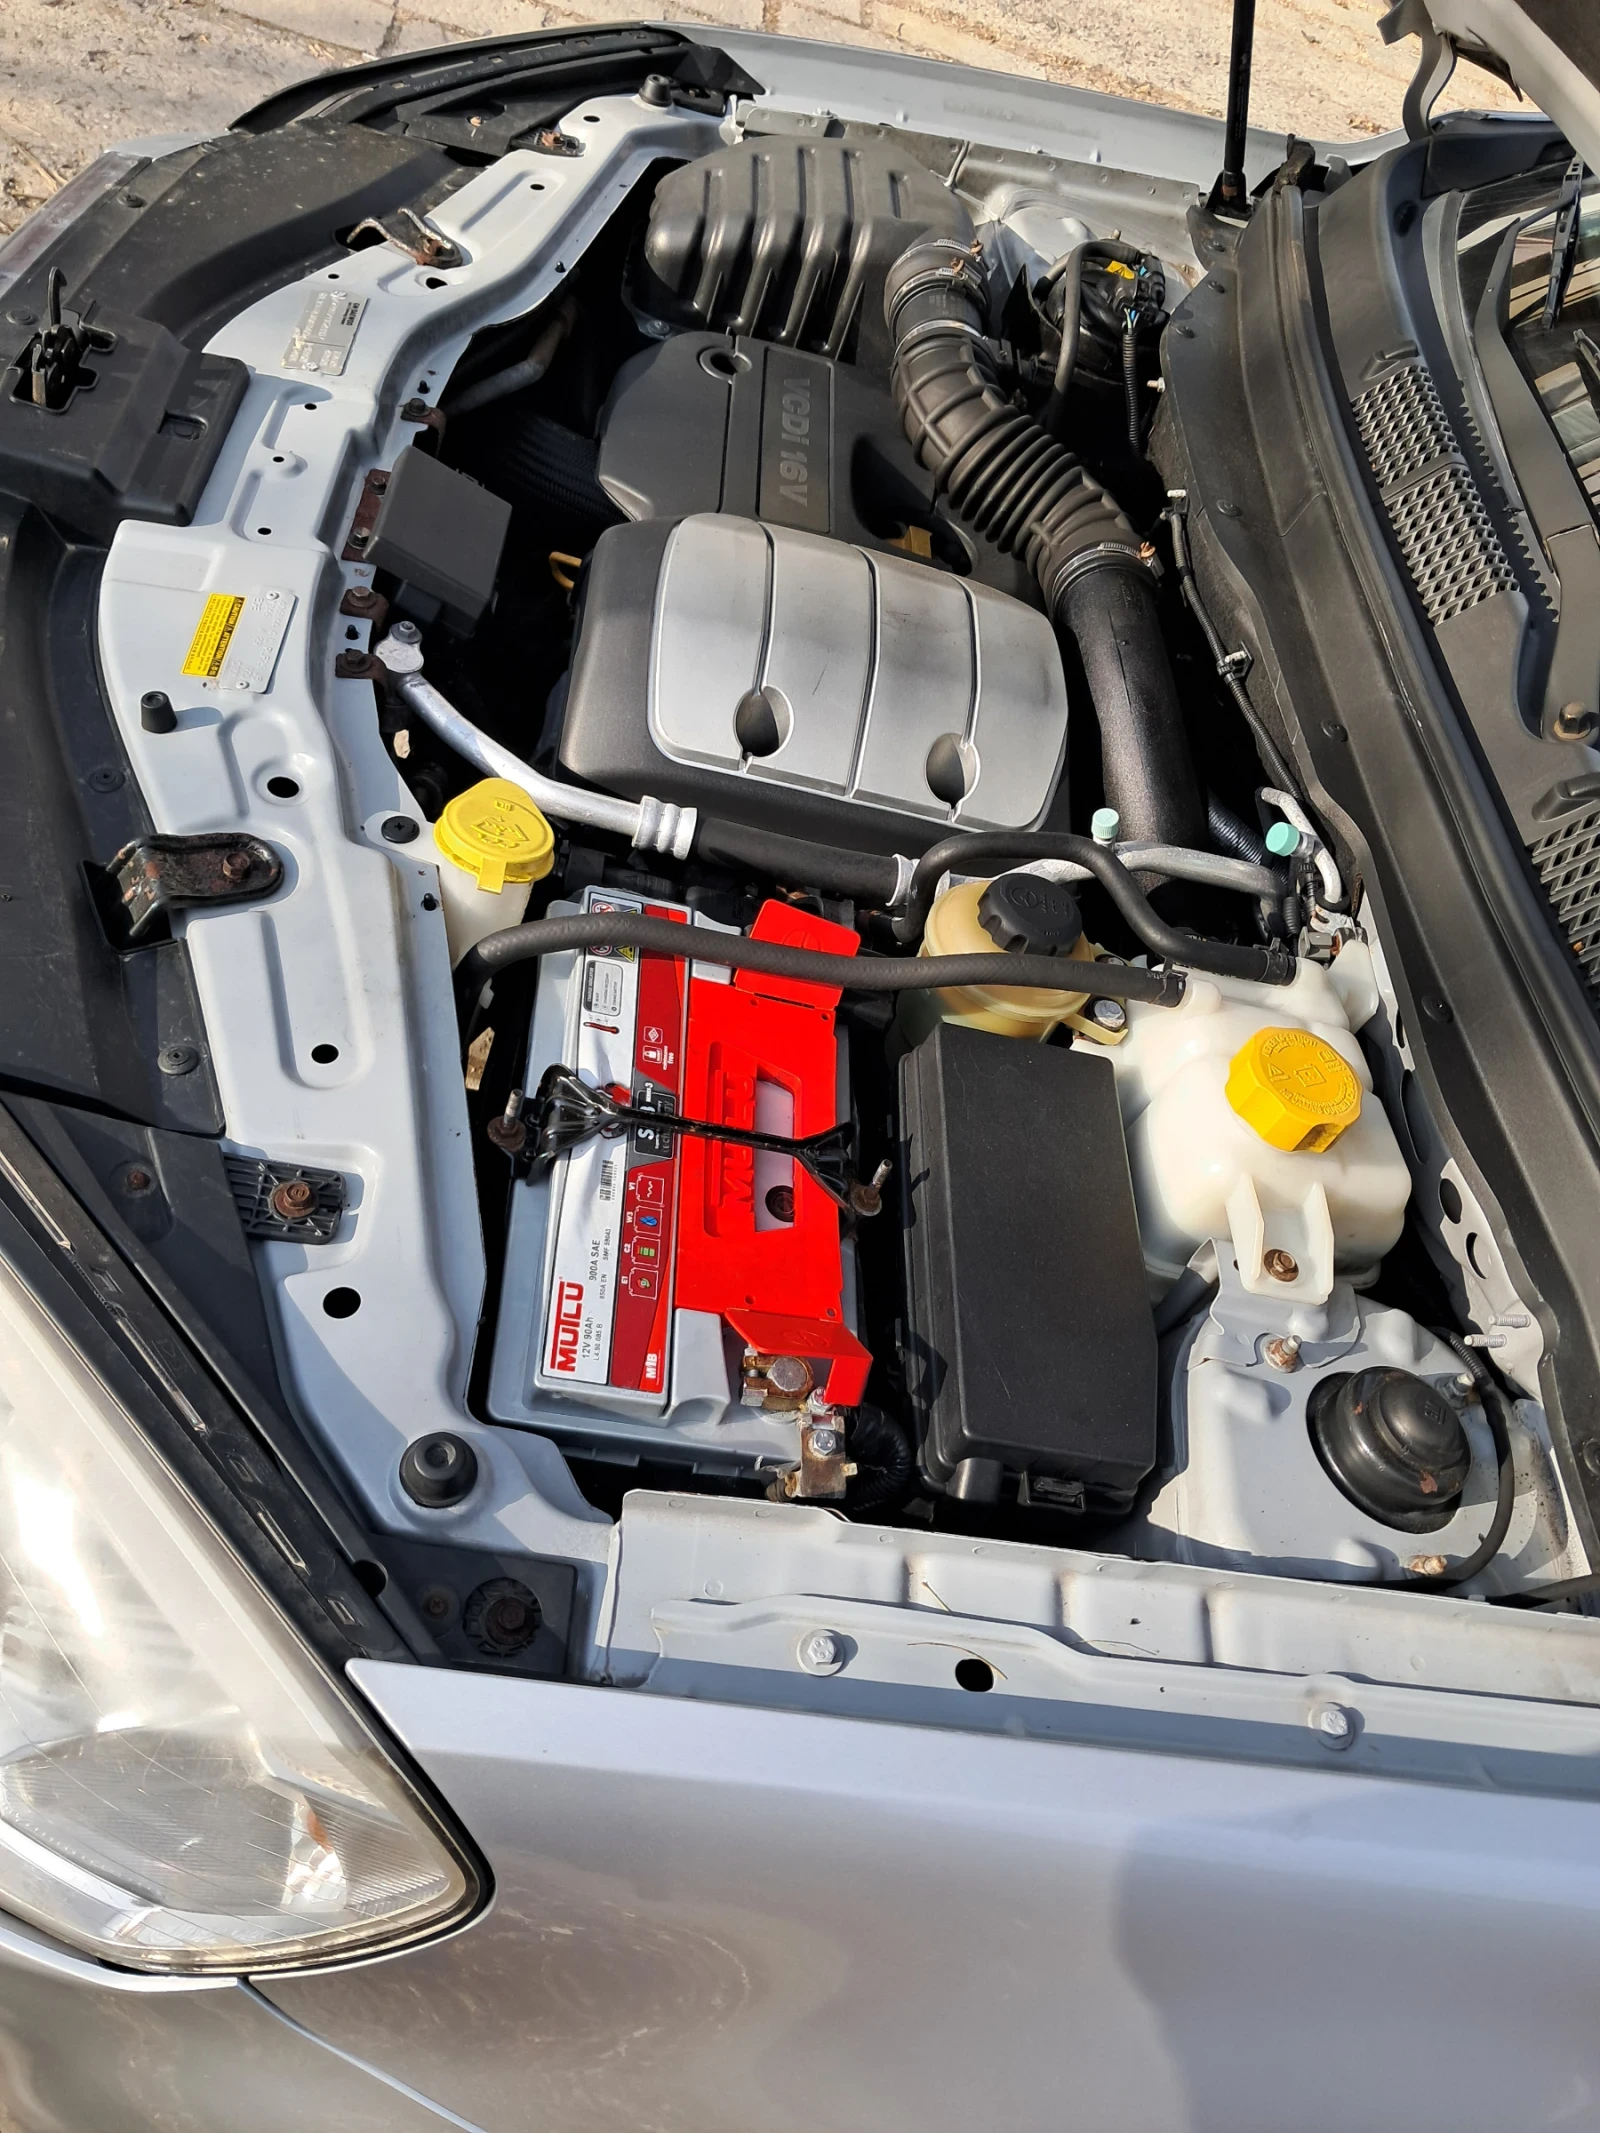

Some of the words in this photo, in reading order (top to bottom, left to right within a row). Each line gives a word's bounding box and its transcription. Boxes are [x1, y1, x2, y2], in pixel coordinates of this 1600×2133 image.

[782, 377, 811, 447] VCDi
[779, 449, 808, 507] 16V
[227, 602, 243, 625] CAUTION
[215, 631, 231, 658] ATTENTION
[626, 1211, 633, 1223] W3
[591, 1240, 600, 1258] SAE
[624, 1243, 631, 1253] C2
[588, 1260, 599, 1281] 900A
[601, 1274, 607, 1282] EN
[621, 1276, 628, 1284] E1
[550, 1281, 584, 1372] MUTLU
[584, 1316, 594, 1340] 90Ah
[582, 1342, 591, 1359] 12V
